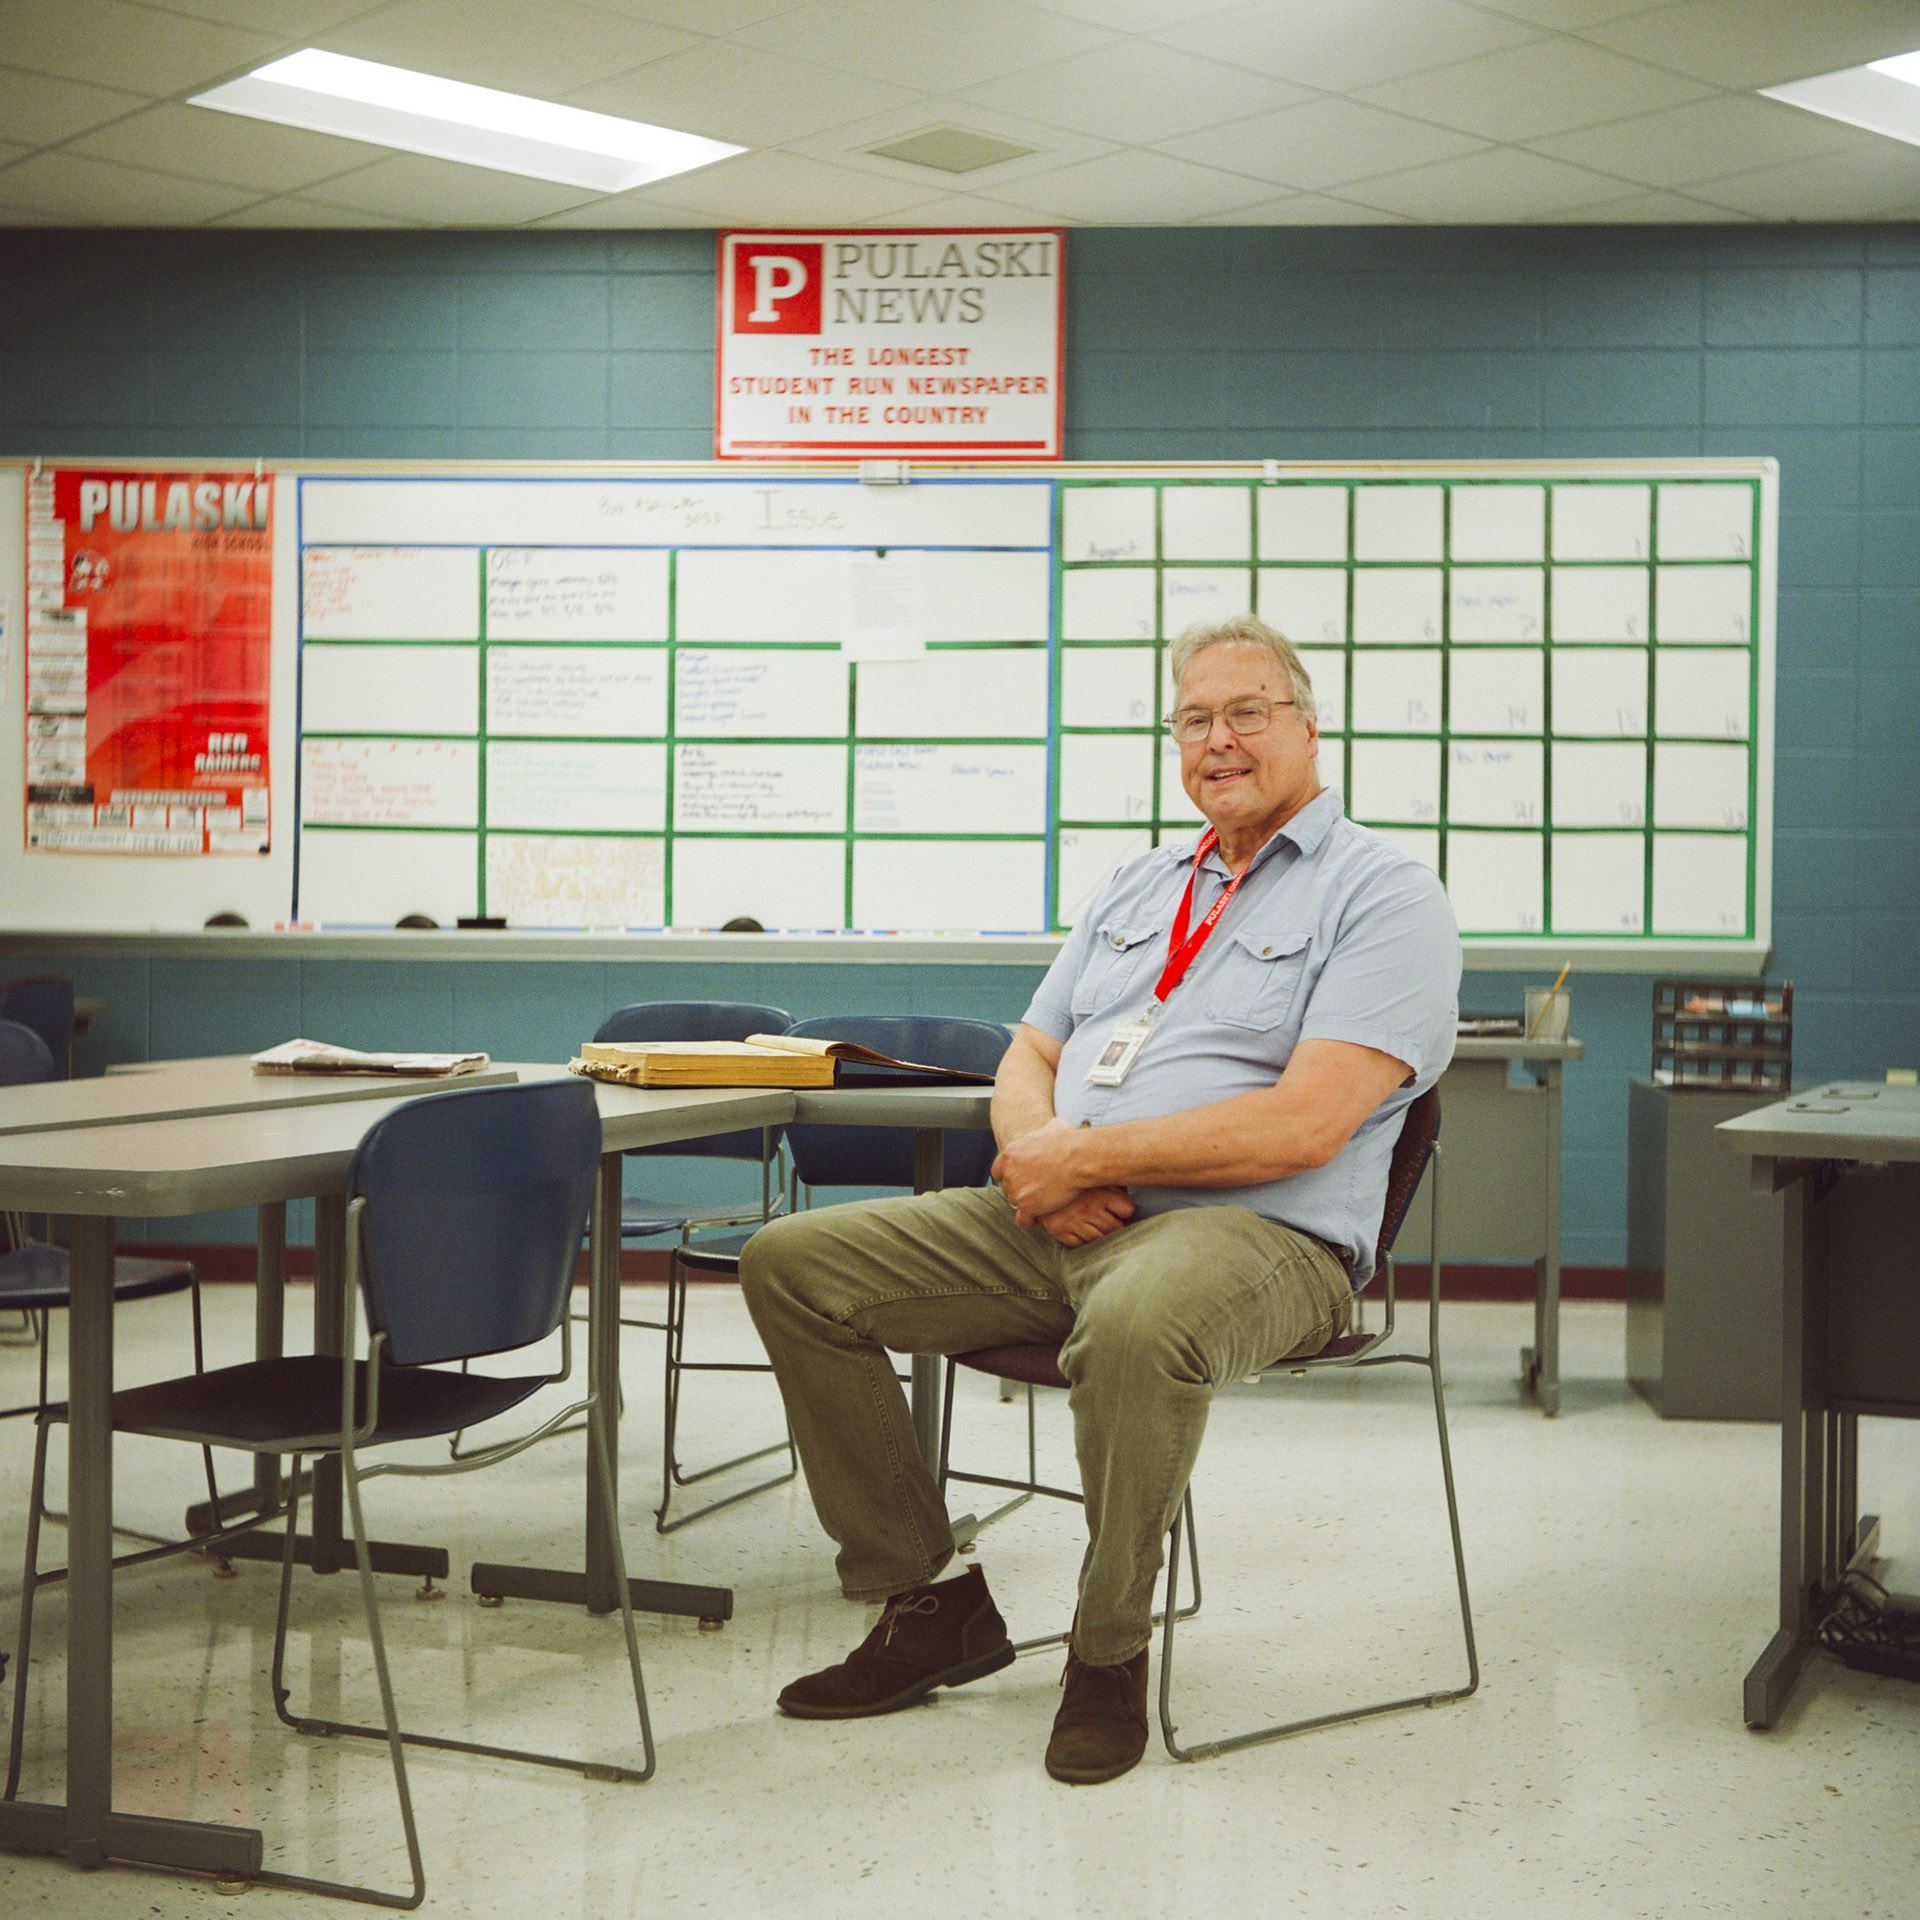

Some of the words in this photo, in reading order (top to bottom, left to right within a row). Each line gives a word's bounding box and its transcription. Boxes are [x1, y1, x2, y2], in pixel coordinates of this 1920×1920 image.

[833, 241, 1053, 279] PULASKI
[748, 255, 808, 322] P
[834, 287, 985, 324] NEWS
[808, 347, 855, 366] THE
[867, 347, 971, 366] LONGEST
[729, 376, 835, 395] STUDENT
[847, 376, 895, 395] RUN
[906, 376, 1049, 395] NEWSPAPER
[788, 406, 812, 424] IN
[825, 406, 871, 424] THE
[882, 406, 990, 424] COUNTRY
[80, 480, 270, 532] PULASKI
[1205, 892, 1231, 925] PULASKI
